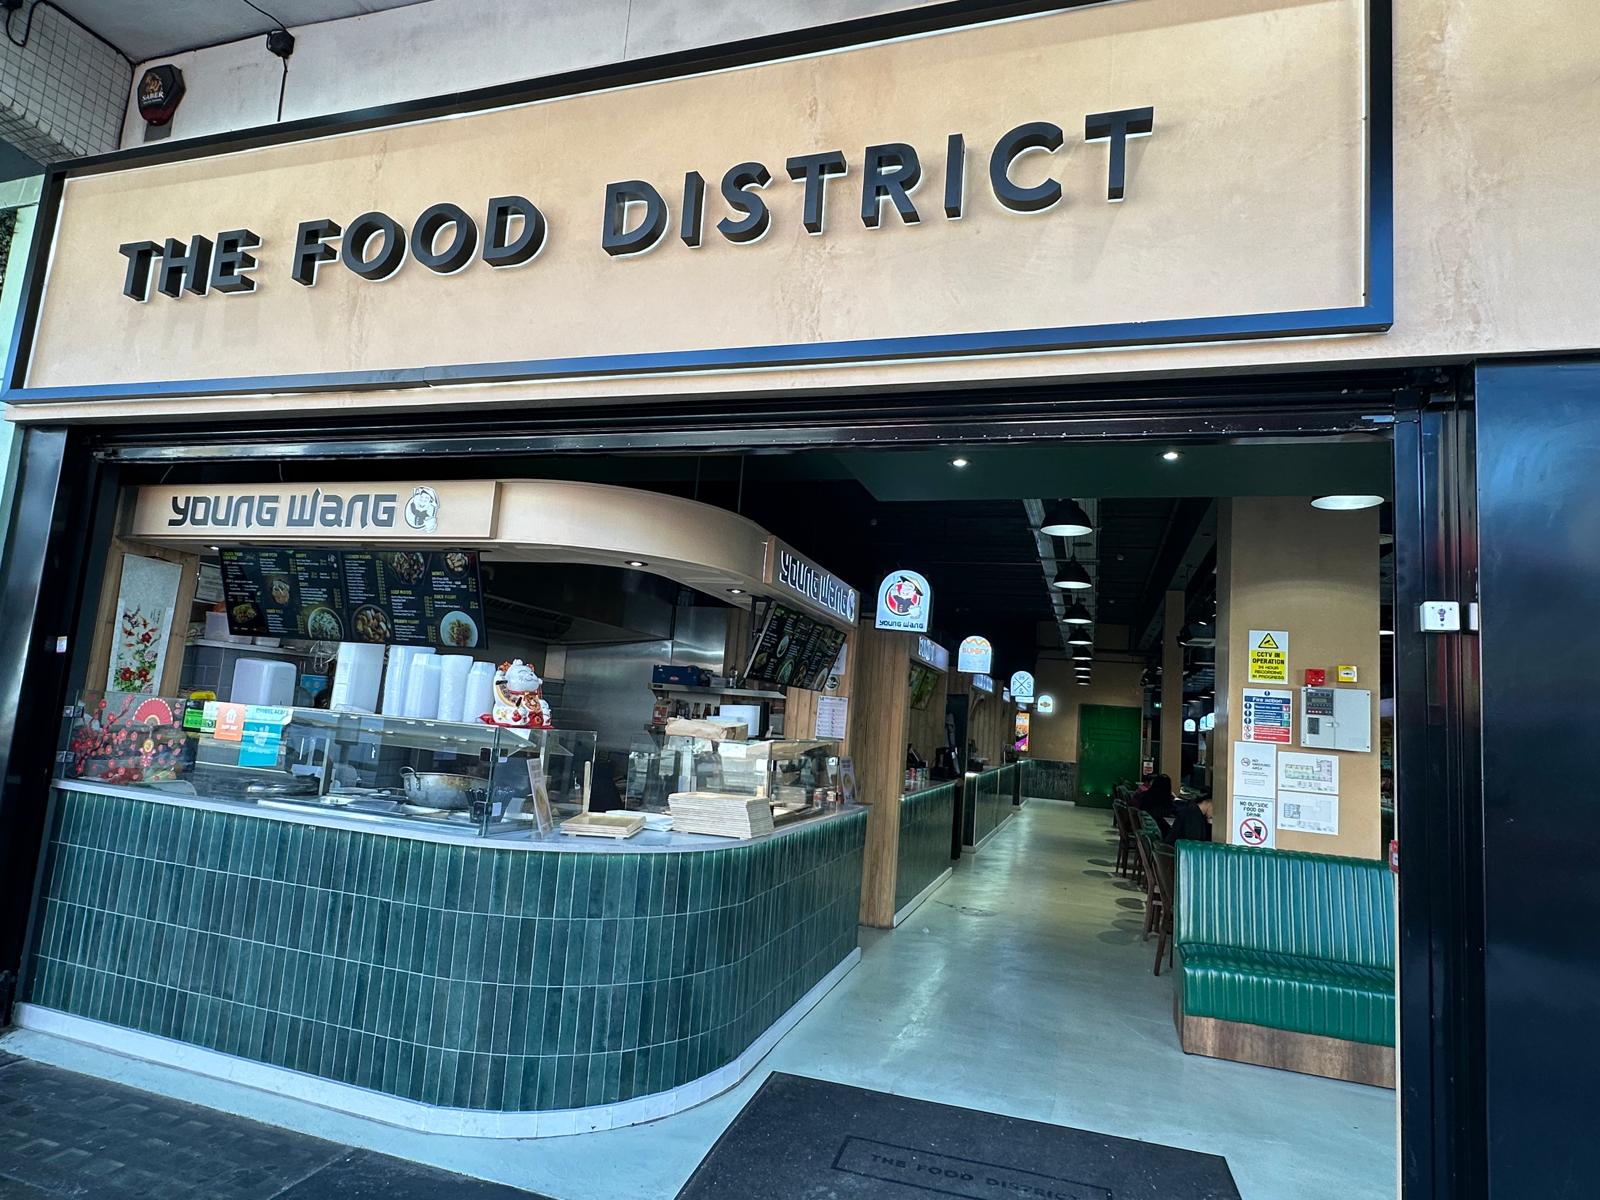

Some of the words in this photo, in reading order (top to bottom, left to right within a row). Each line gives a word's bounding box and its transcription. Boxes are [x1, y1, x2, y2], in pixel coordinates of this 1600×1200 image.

[119, 228, 262, 302] THE
[291, 195, 548, 287] FOOD
[601, 106, 1154, 258] DISTRICT
[1252, 657, 1285, 665] OPERATION
[872, 1154, 906, 1168] THE
[917, 1164, 974, 1181] FOOD
